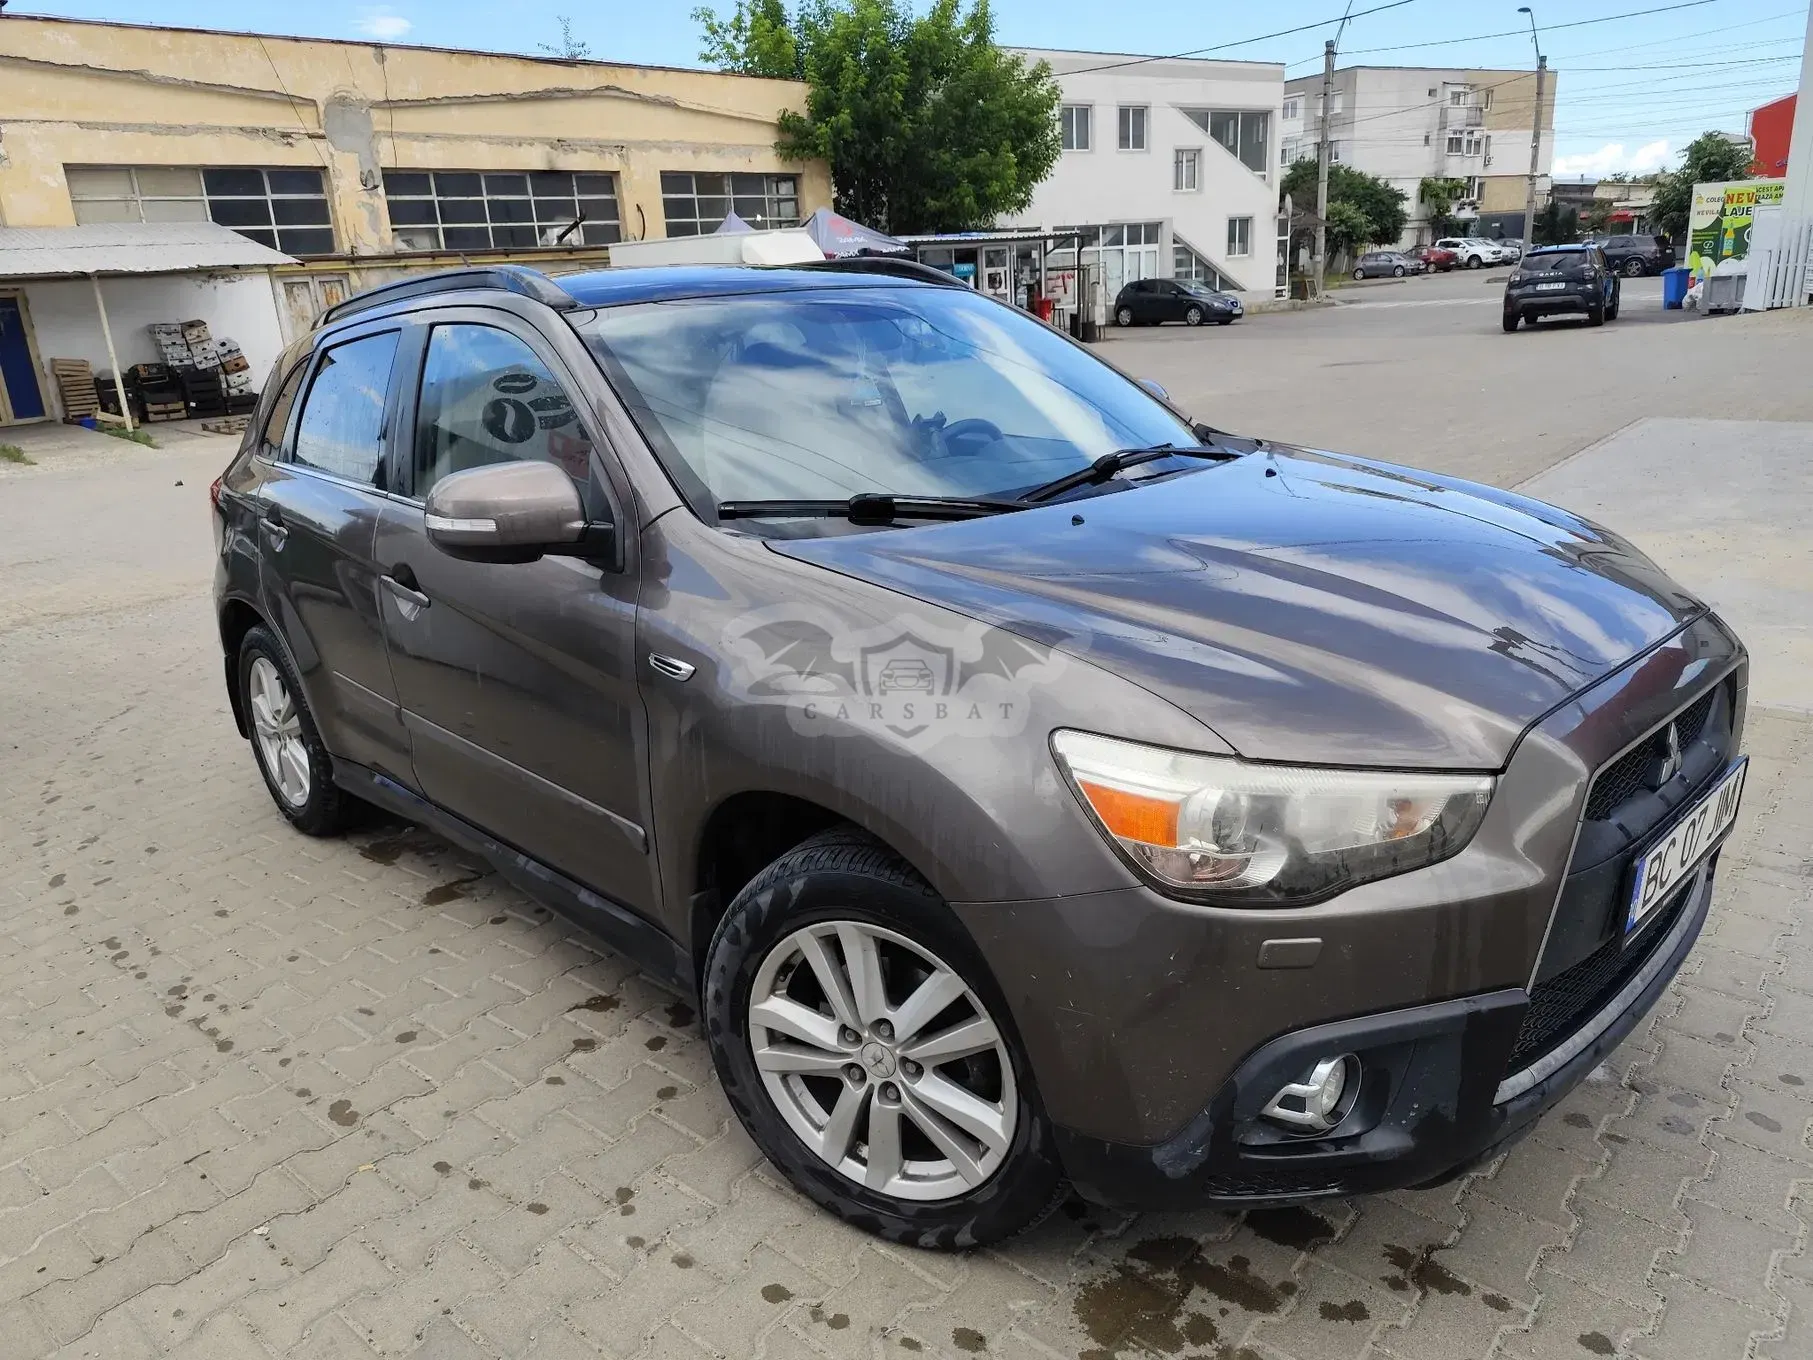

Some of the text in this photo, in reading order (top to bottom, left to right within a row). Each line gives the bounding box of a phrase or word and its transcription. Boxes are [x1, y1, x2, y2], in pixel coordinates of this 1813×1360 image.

[1723, 206, 1753, 217] LAJE
[1641, 836, 1677, 909] BC
[1680, 803, 1709, 869] 07
